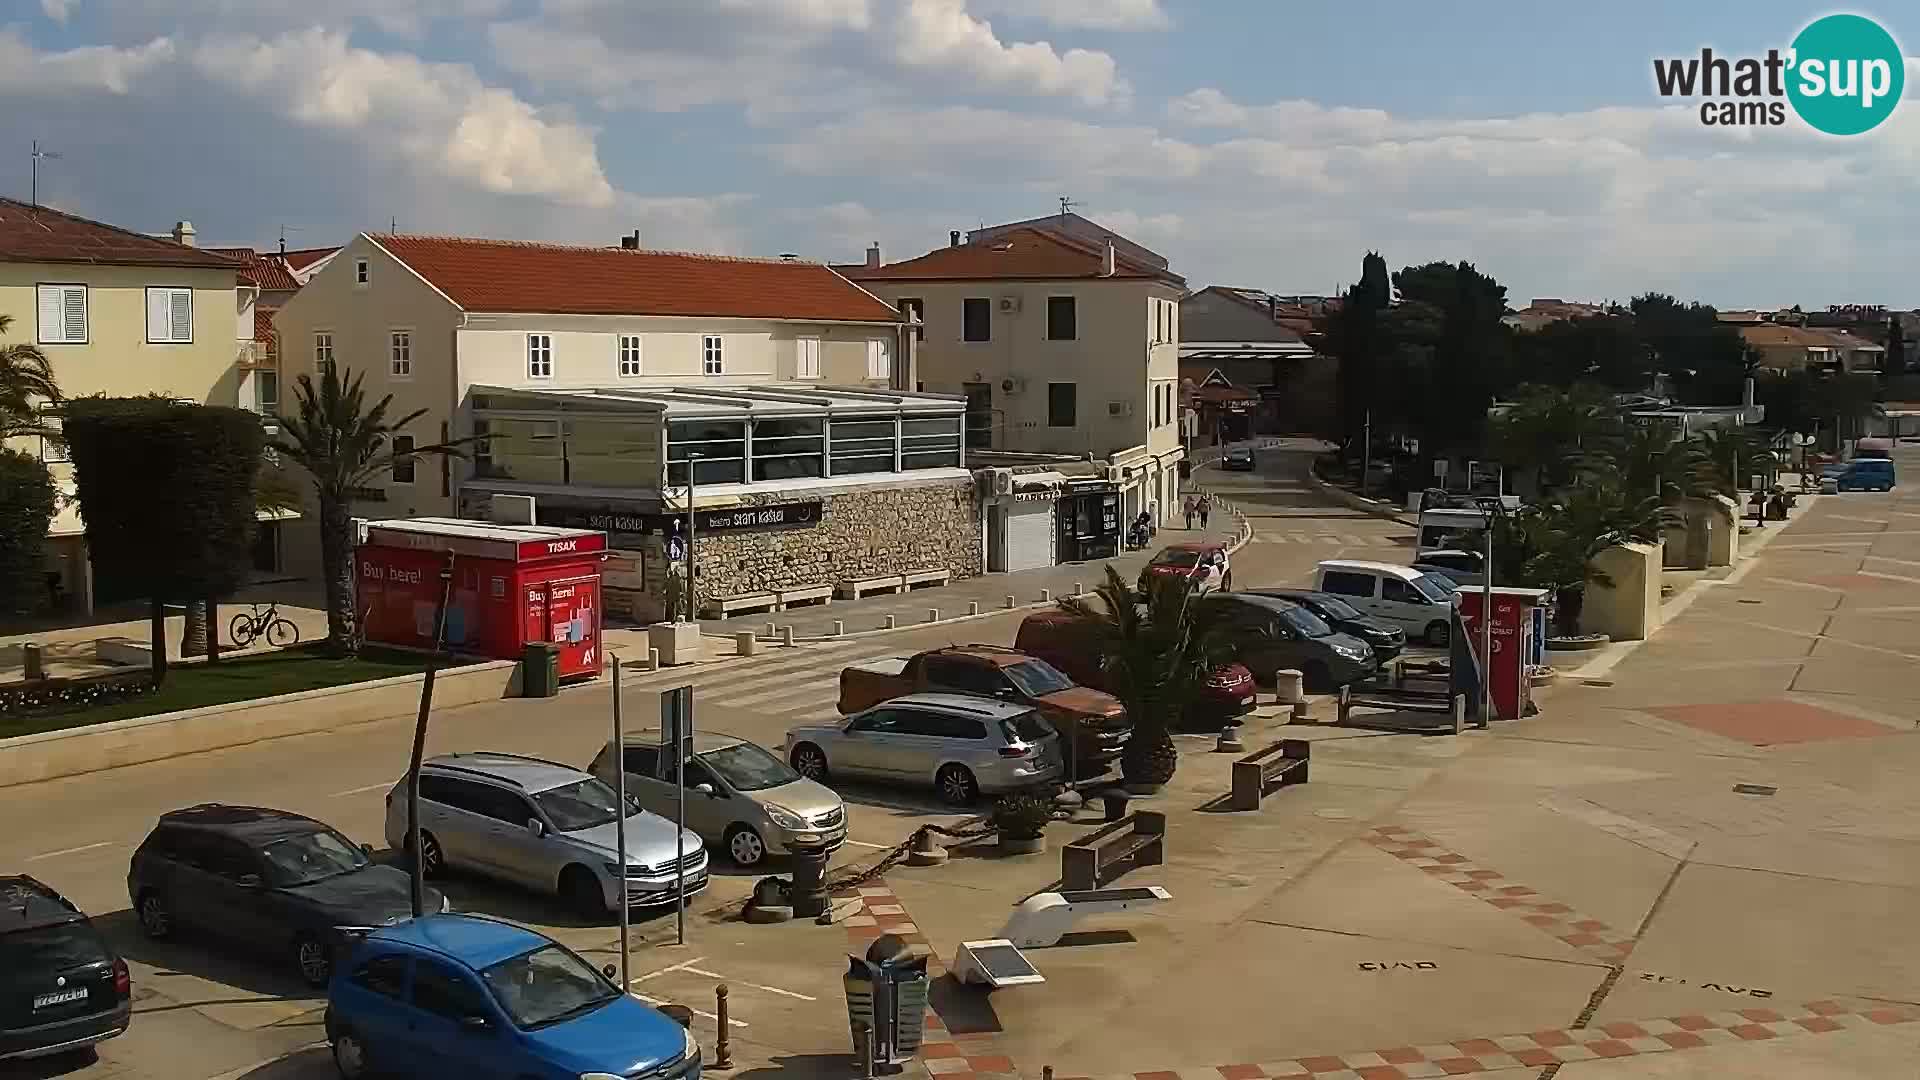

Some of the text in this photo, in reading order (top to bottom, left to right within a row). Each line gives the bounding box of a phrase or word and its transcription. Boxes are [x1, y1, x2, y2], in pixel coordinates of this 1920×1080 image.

[547, 540, 577, 553] TISAK
[363, 562, 422, 584] Buy here!
[529, 586, 575, 603] Buy here!
[1358, 961, 1437, 970] CIAO
